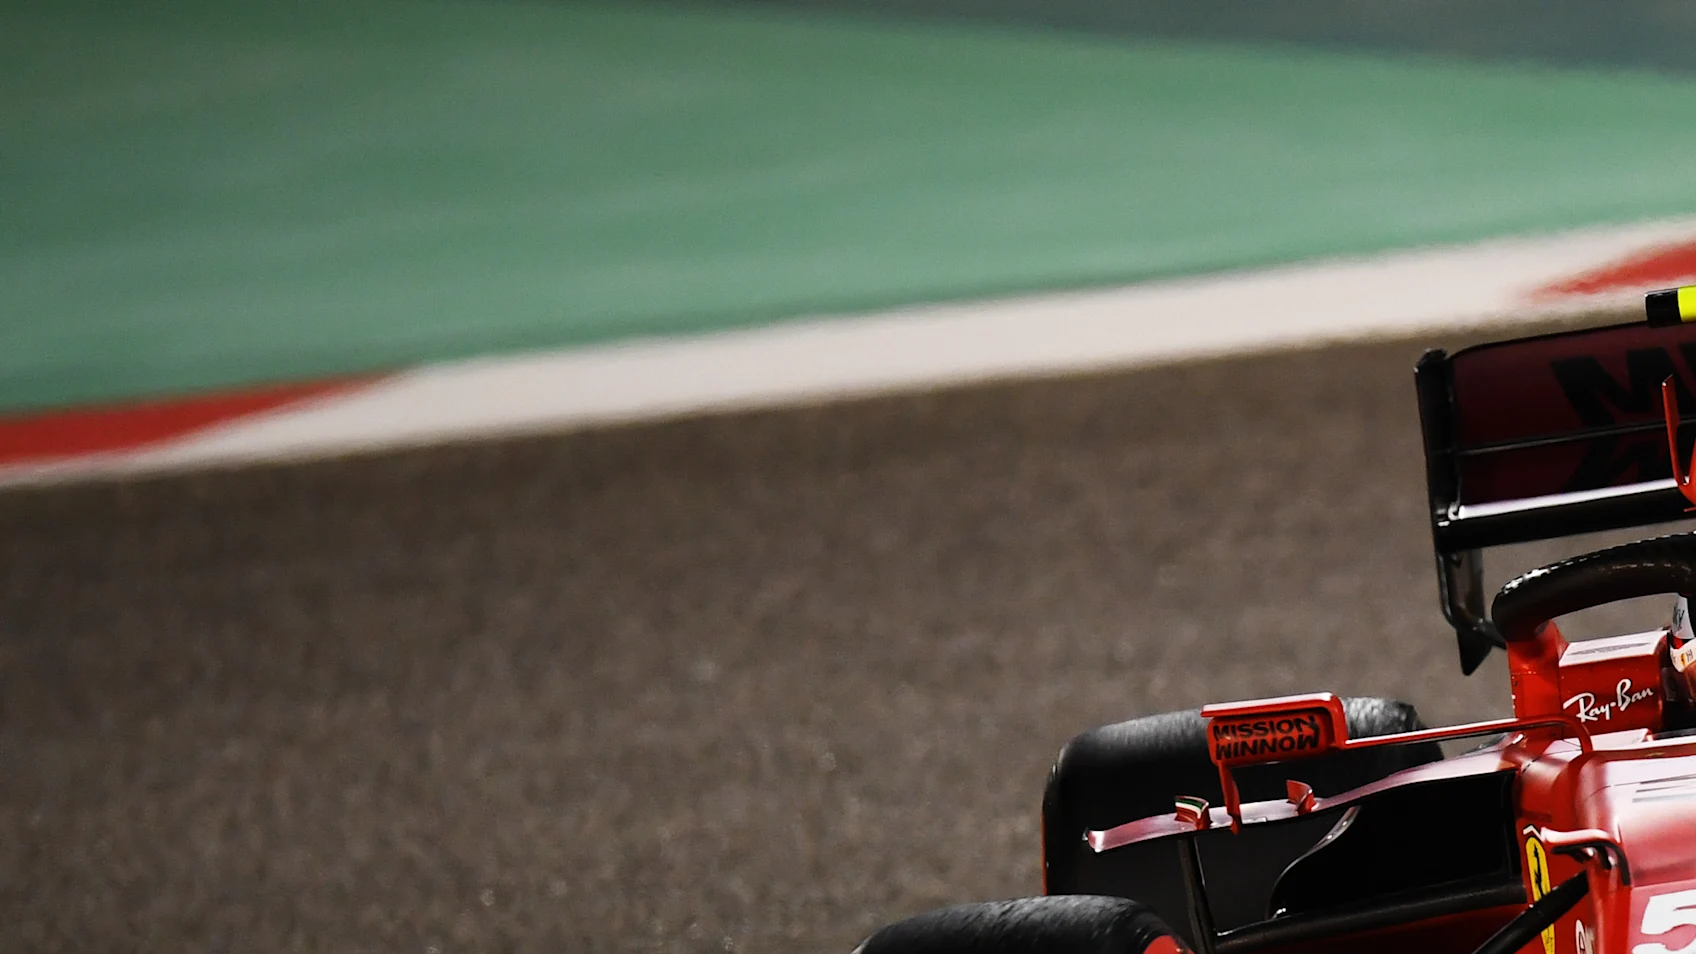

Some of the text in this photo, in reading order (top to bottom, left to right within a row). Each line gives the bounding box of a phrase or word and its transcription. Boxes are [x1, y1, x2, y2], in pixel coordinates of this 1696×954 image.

[1563, 678, 1654, 723] Ray-Ban
[1213, 714, 1320, 741] MISSION
[1216, 734, 1320, 760] WINNOW
